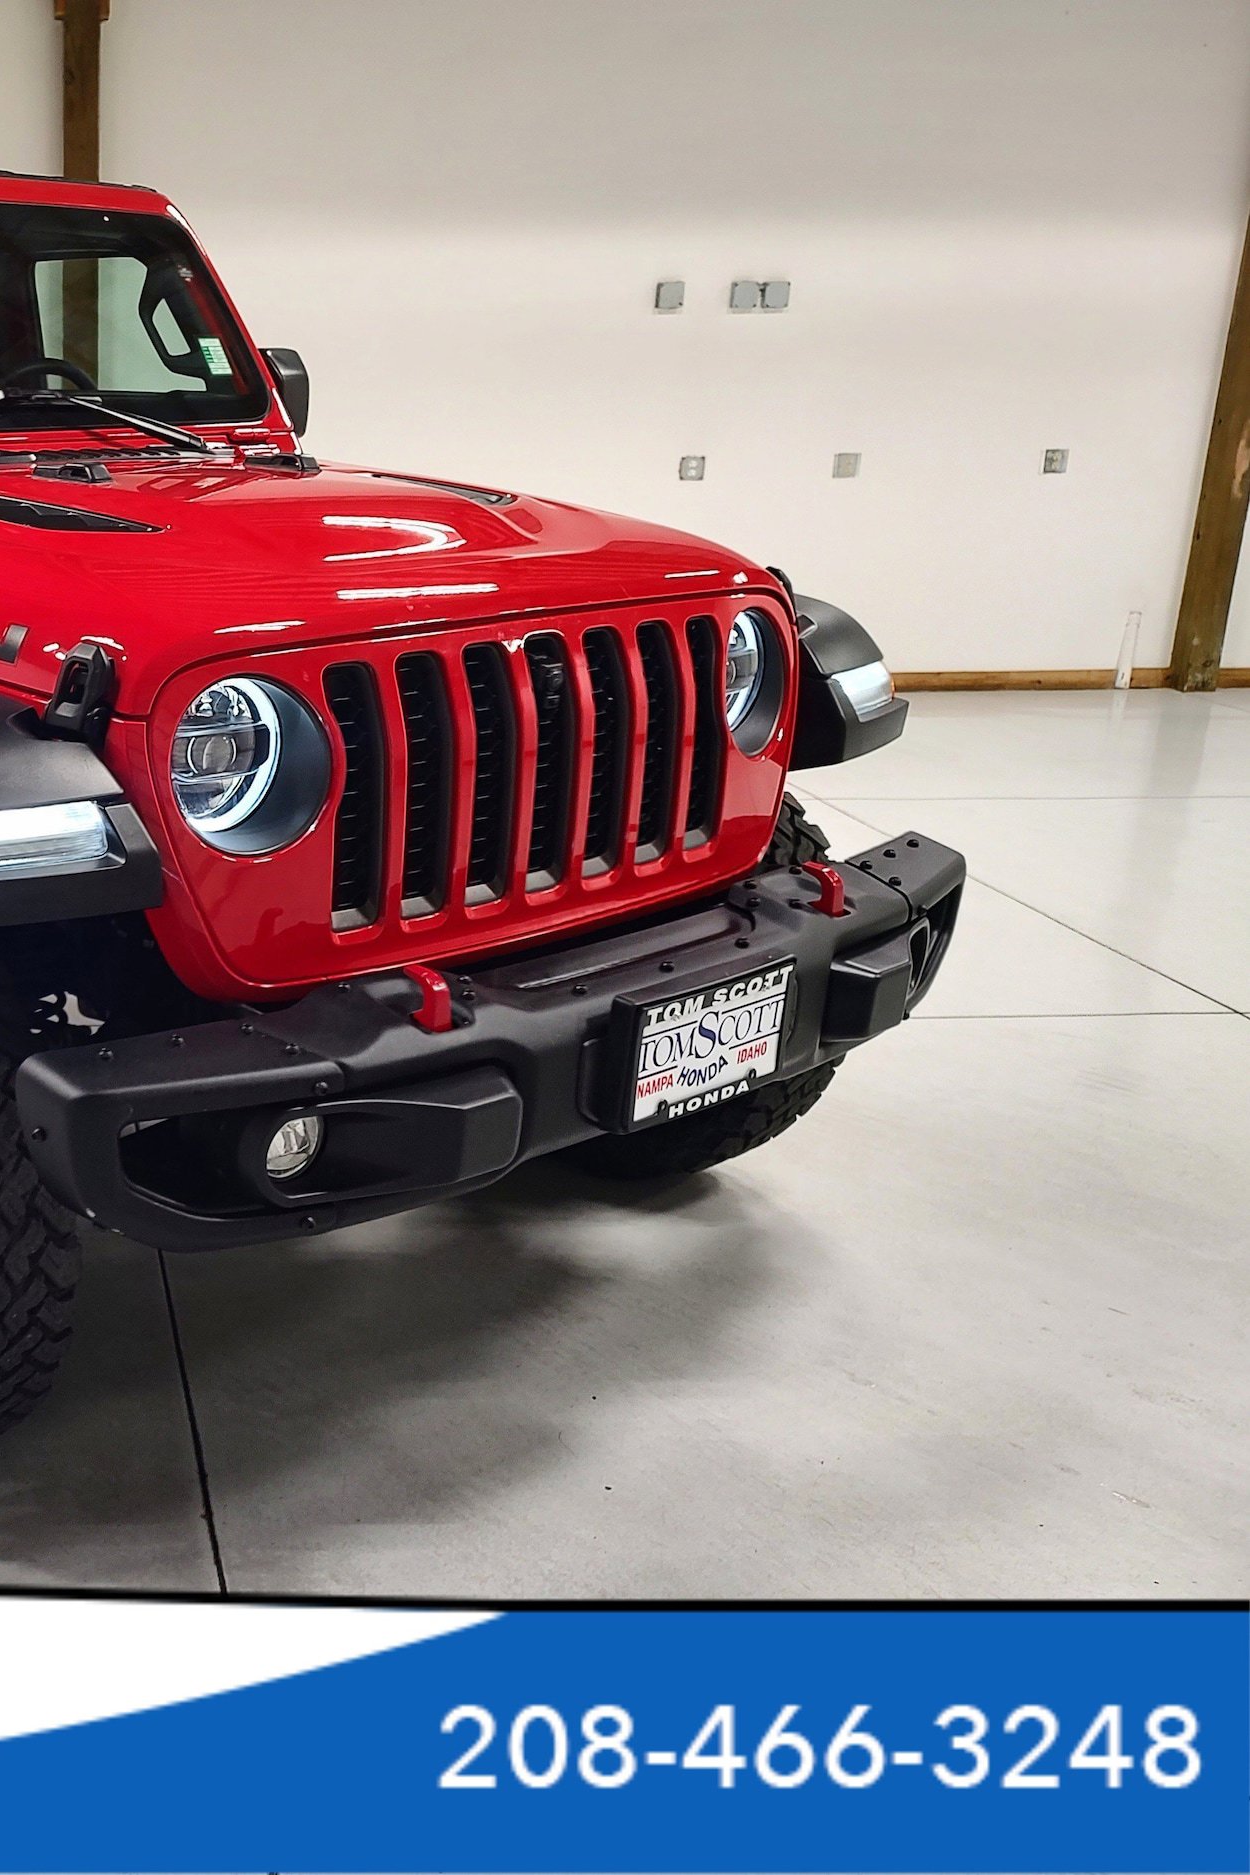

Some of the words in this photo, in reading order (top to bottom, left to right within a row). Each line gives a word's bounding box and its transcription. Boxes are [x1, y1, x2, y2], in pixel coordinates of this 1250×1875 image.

[647, 996, 705, 1025] TOM
[713, 966, 794, 1004] SCOTT
[637, 1074, 674, 1099] NAMPA
[678, 1055, 728, 1086] HONDA
[737, 1041, 767, 1064] IDAHO
[669, 1081, 750, 1118] HONDA
